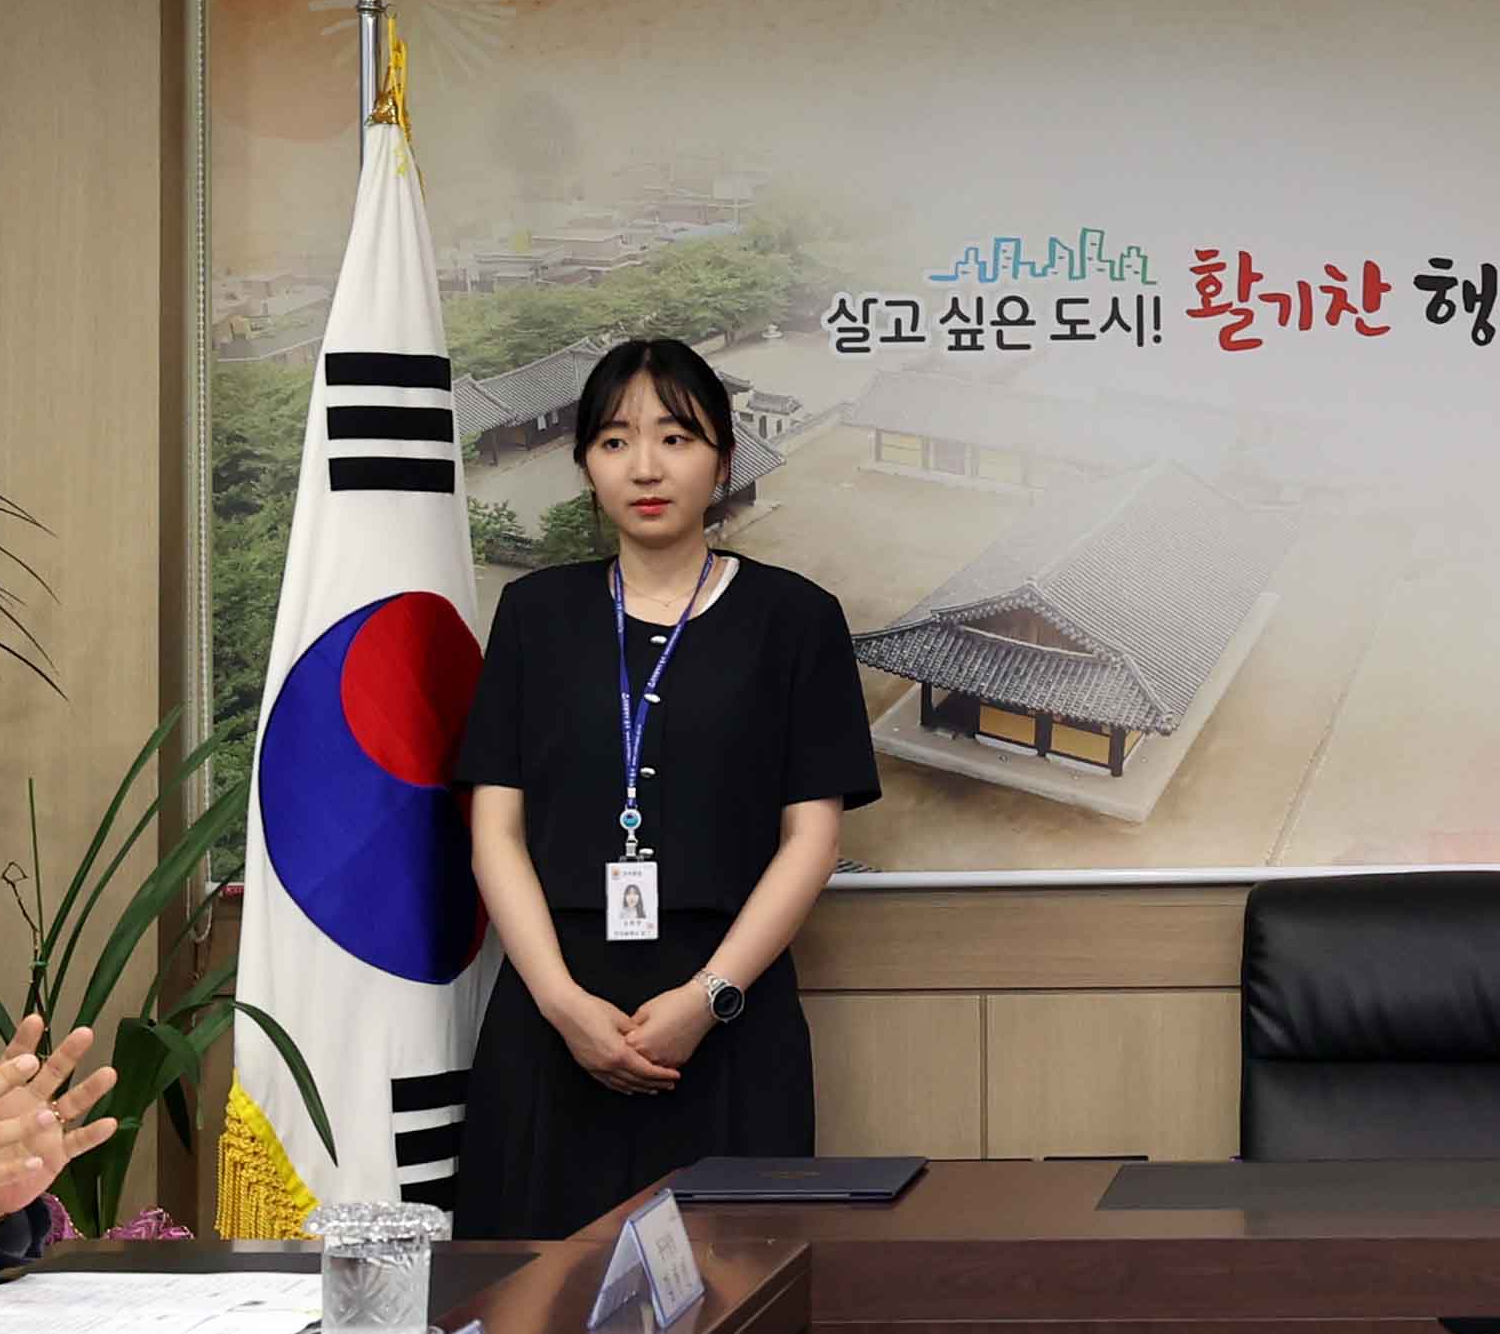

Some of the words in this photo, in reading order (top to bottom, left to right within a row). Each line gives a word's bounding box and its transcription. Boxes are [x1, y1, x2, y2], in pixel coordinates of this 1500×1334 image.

[826, 297, 927, 354] 살고
[938, 294, 1037, 352] 싶은
[1049, 293, 1163, 349] 도시!
[1185, 248, 1393, 352] 활기찬
